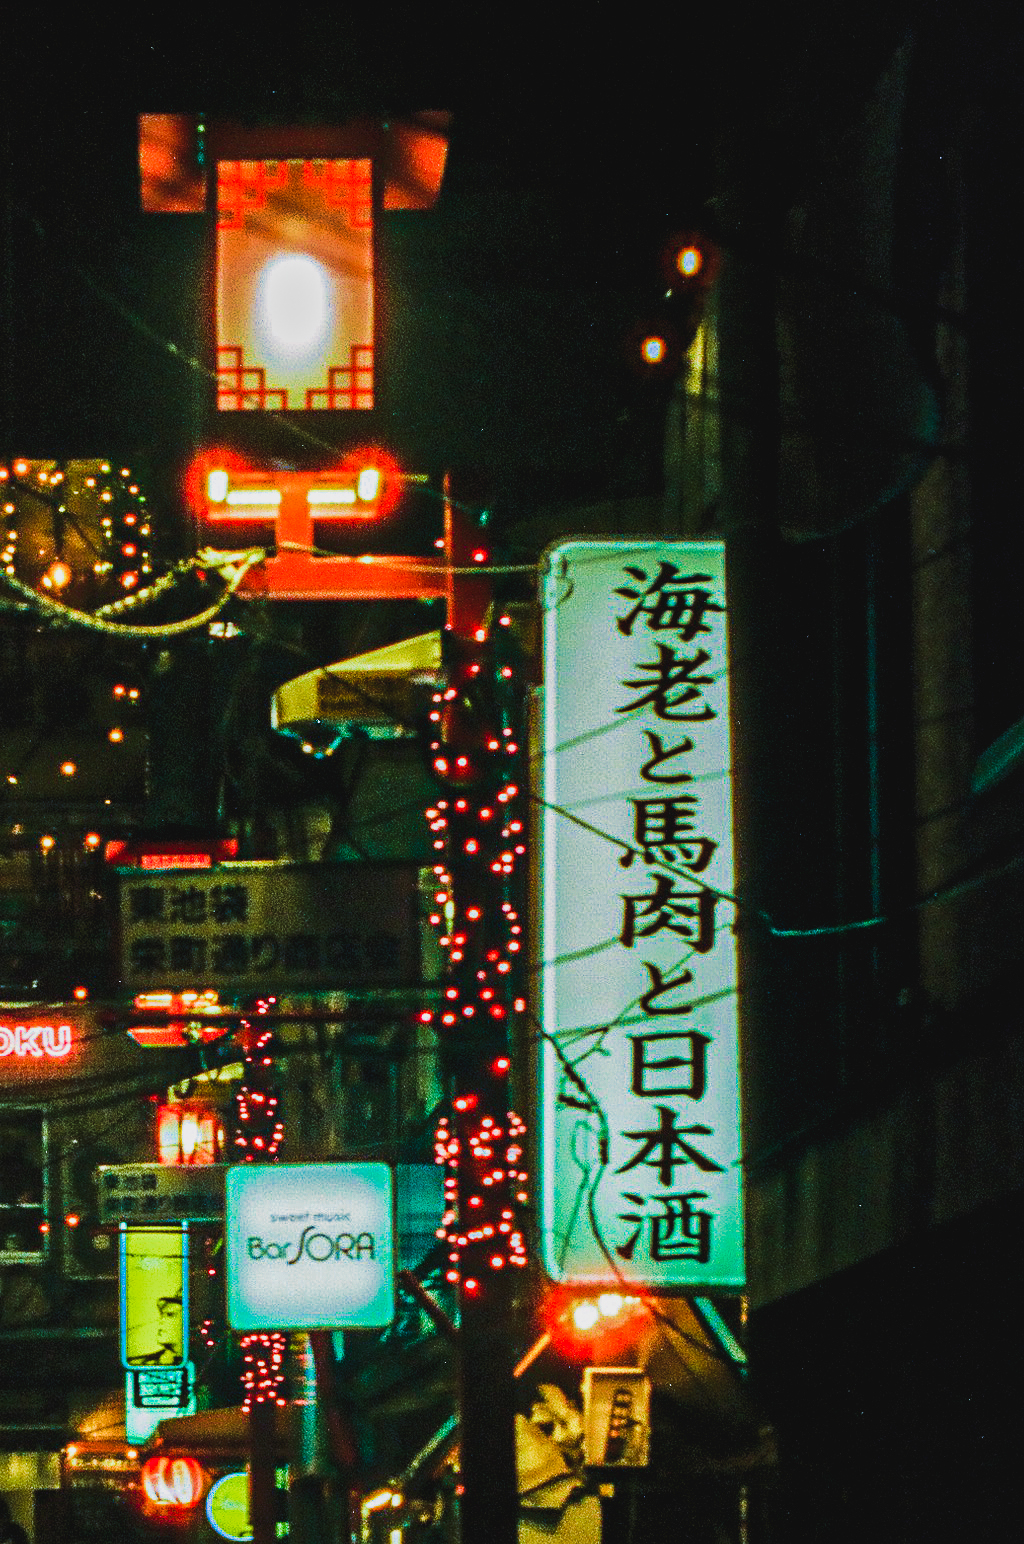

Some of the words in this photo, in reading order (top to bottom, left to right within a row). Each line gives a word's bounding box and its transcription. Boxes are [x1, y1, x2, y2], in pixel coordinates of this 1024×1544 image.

[613, 560, 726, 1264] 海老と馬肉と日本酒
